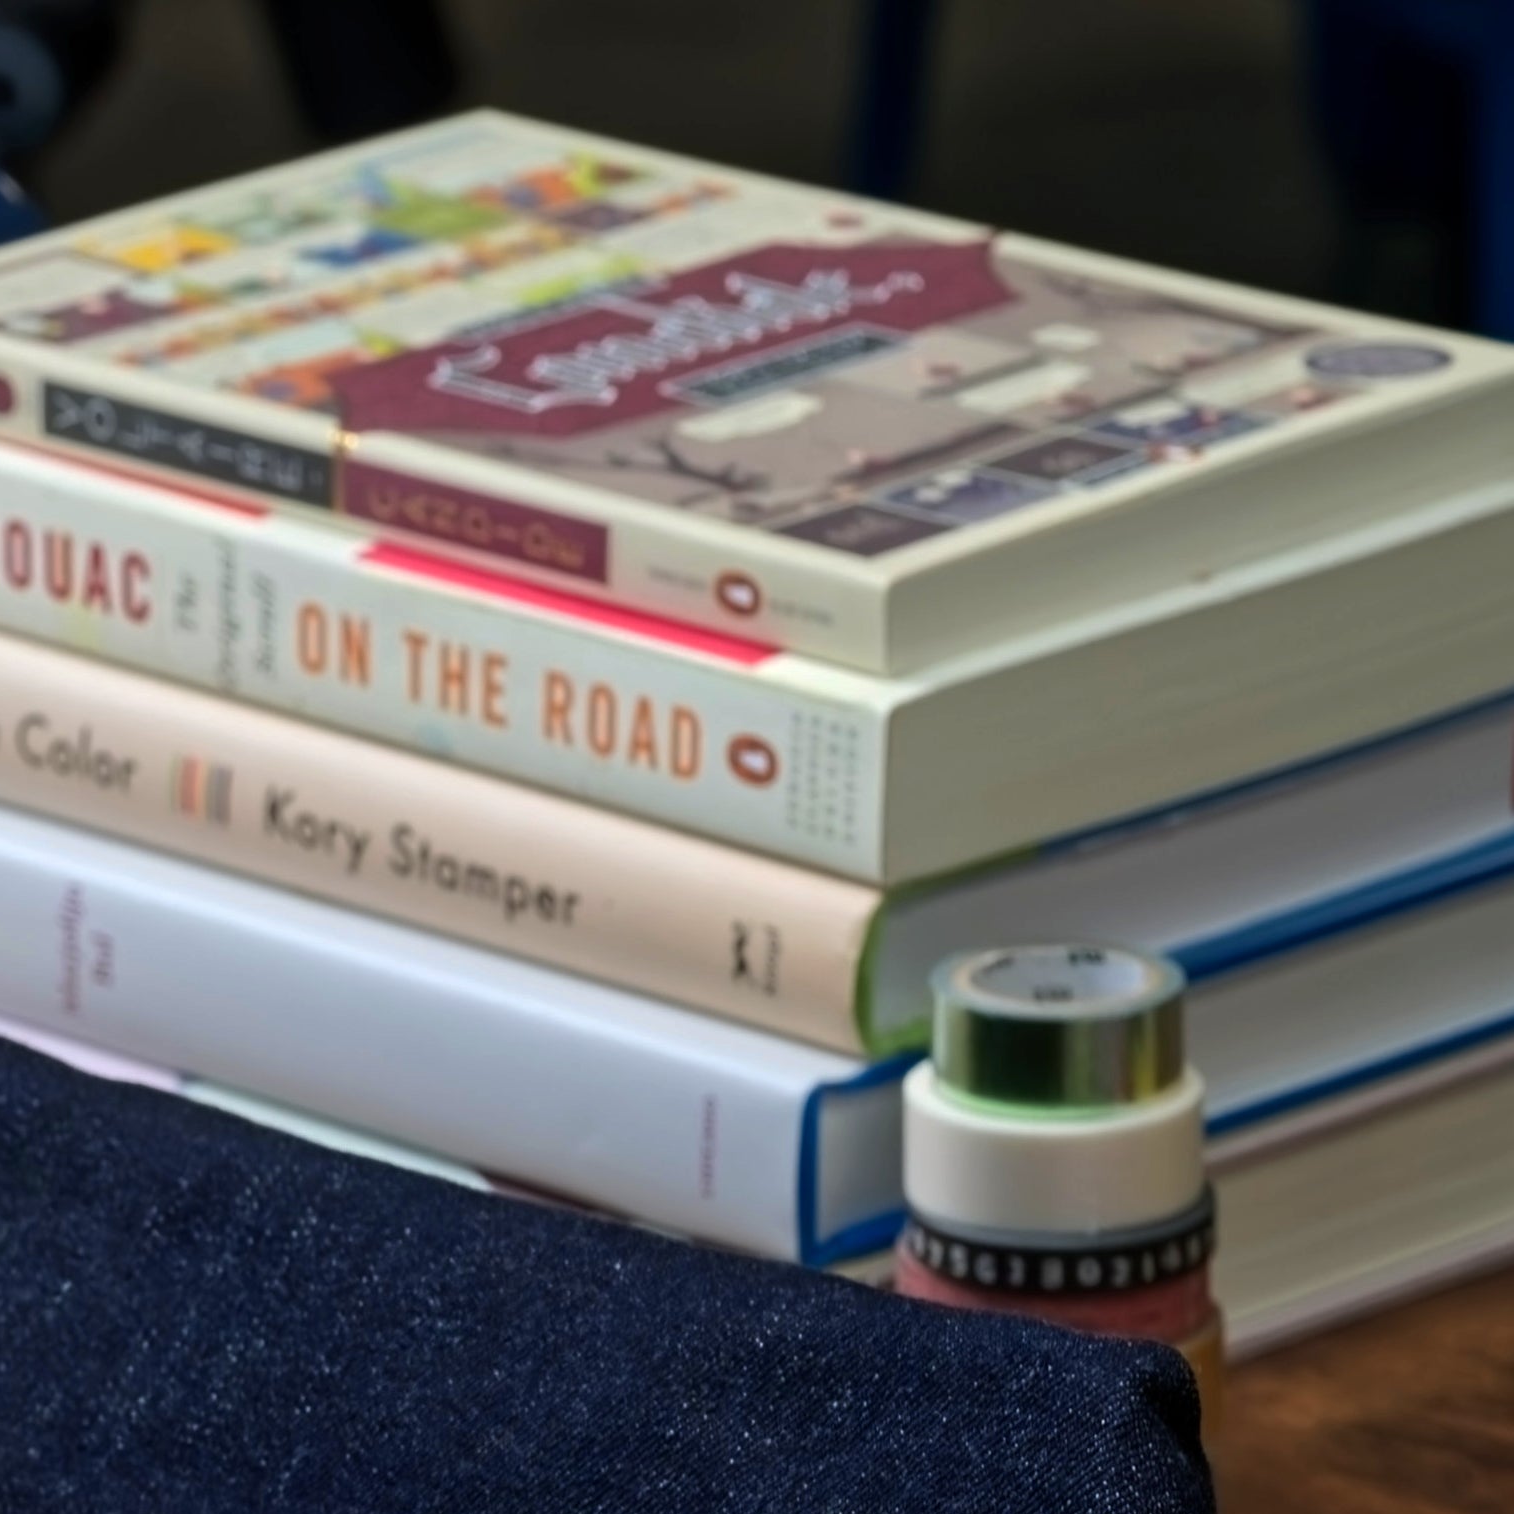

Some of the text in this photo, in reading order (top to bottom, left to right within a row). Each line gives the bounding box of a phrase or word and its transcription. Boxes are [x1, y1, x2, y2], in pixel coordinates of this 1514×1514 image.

[296, 600, 374, 689] ON
[403, 630, 510, 731] THE
[541, 670, 703, 783] ROAD
[14, 710, 136, 796] Color
[264, 780, 370, 872] Kory
[388, 823, 582, 927] Stamper
